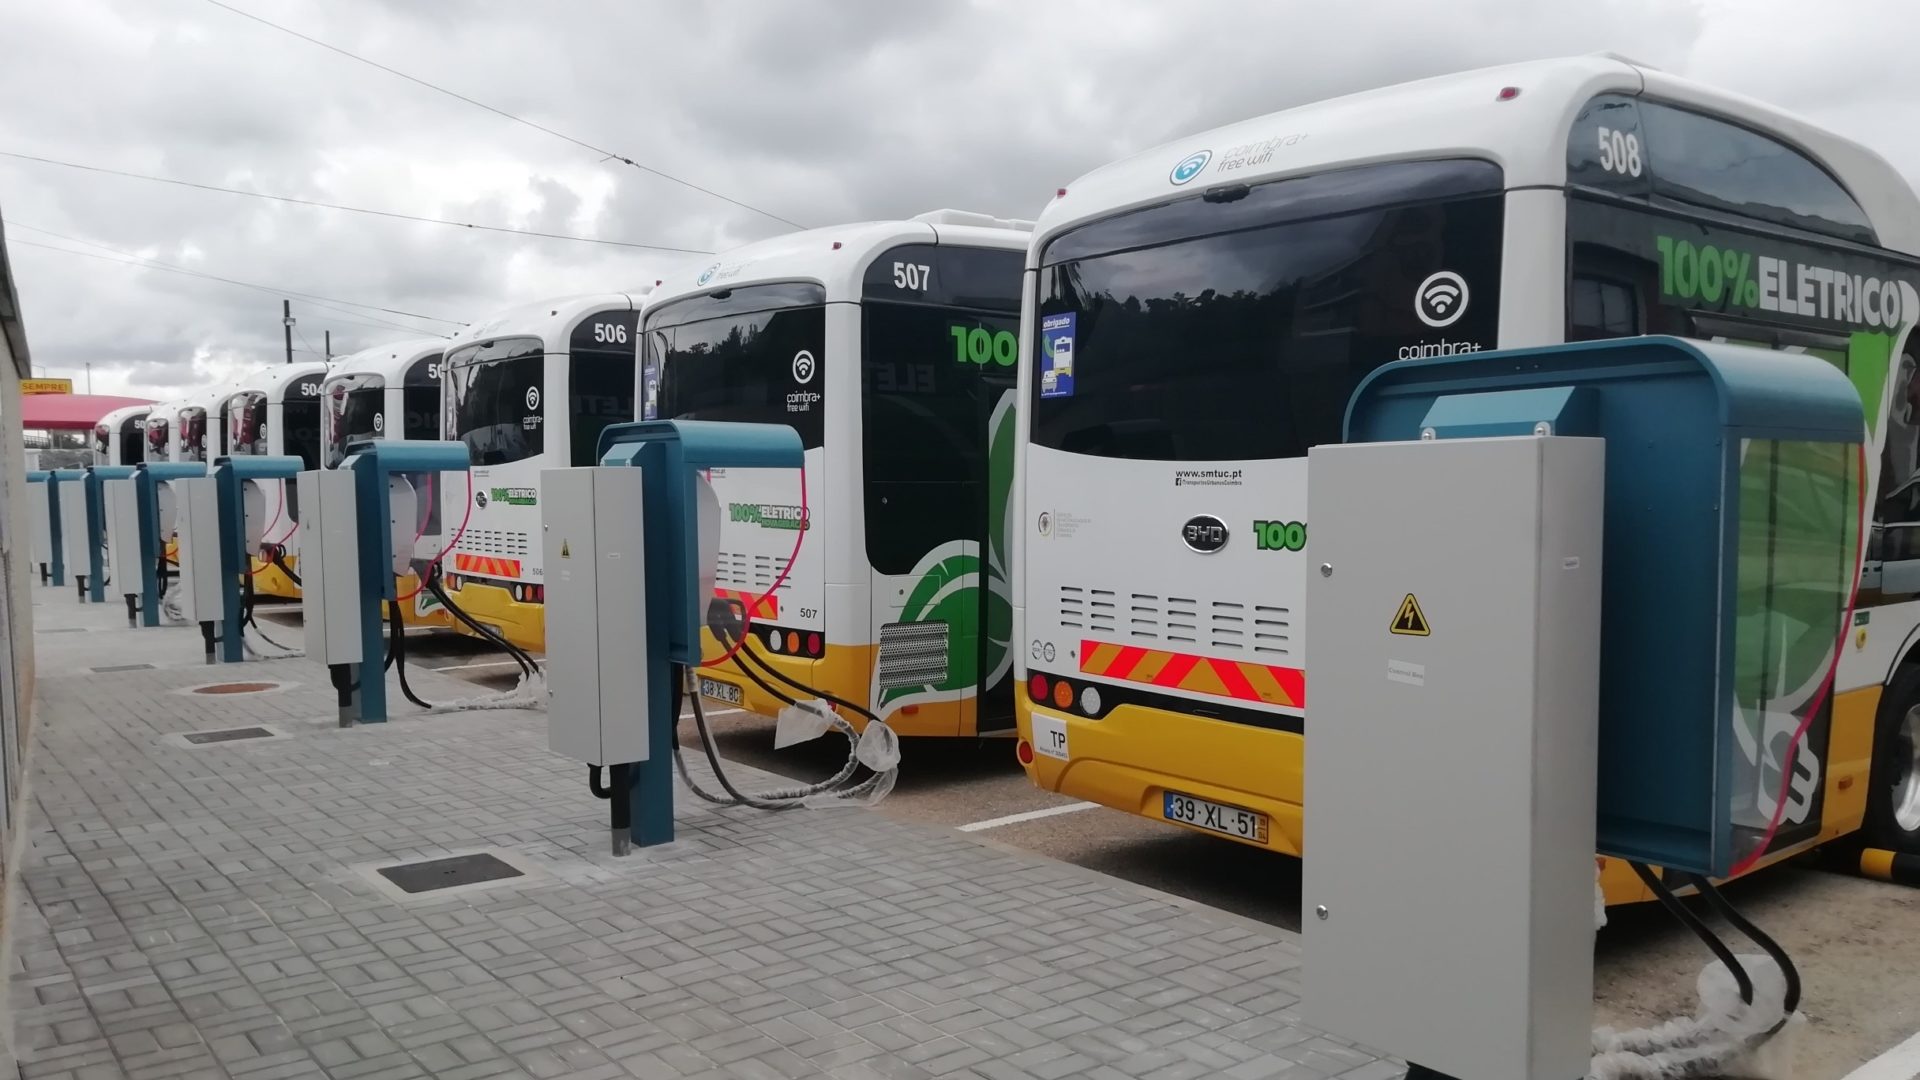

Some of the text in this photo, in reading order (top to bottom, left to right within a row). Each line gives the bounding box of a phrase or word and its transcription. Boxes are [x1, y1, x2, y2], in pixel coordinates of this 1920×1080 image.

[1598, 126, 1642, 178] 508
[893, 261, 930, 292] 507
[593, 323, 627, 344] 506
[1175, 469, 1242, 481] www.smtuc.pt
[1186, 525, 1223, 543] BYD
[799, 608, 818, 619] 507
[1050, 730, 1066, 749] TP
